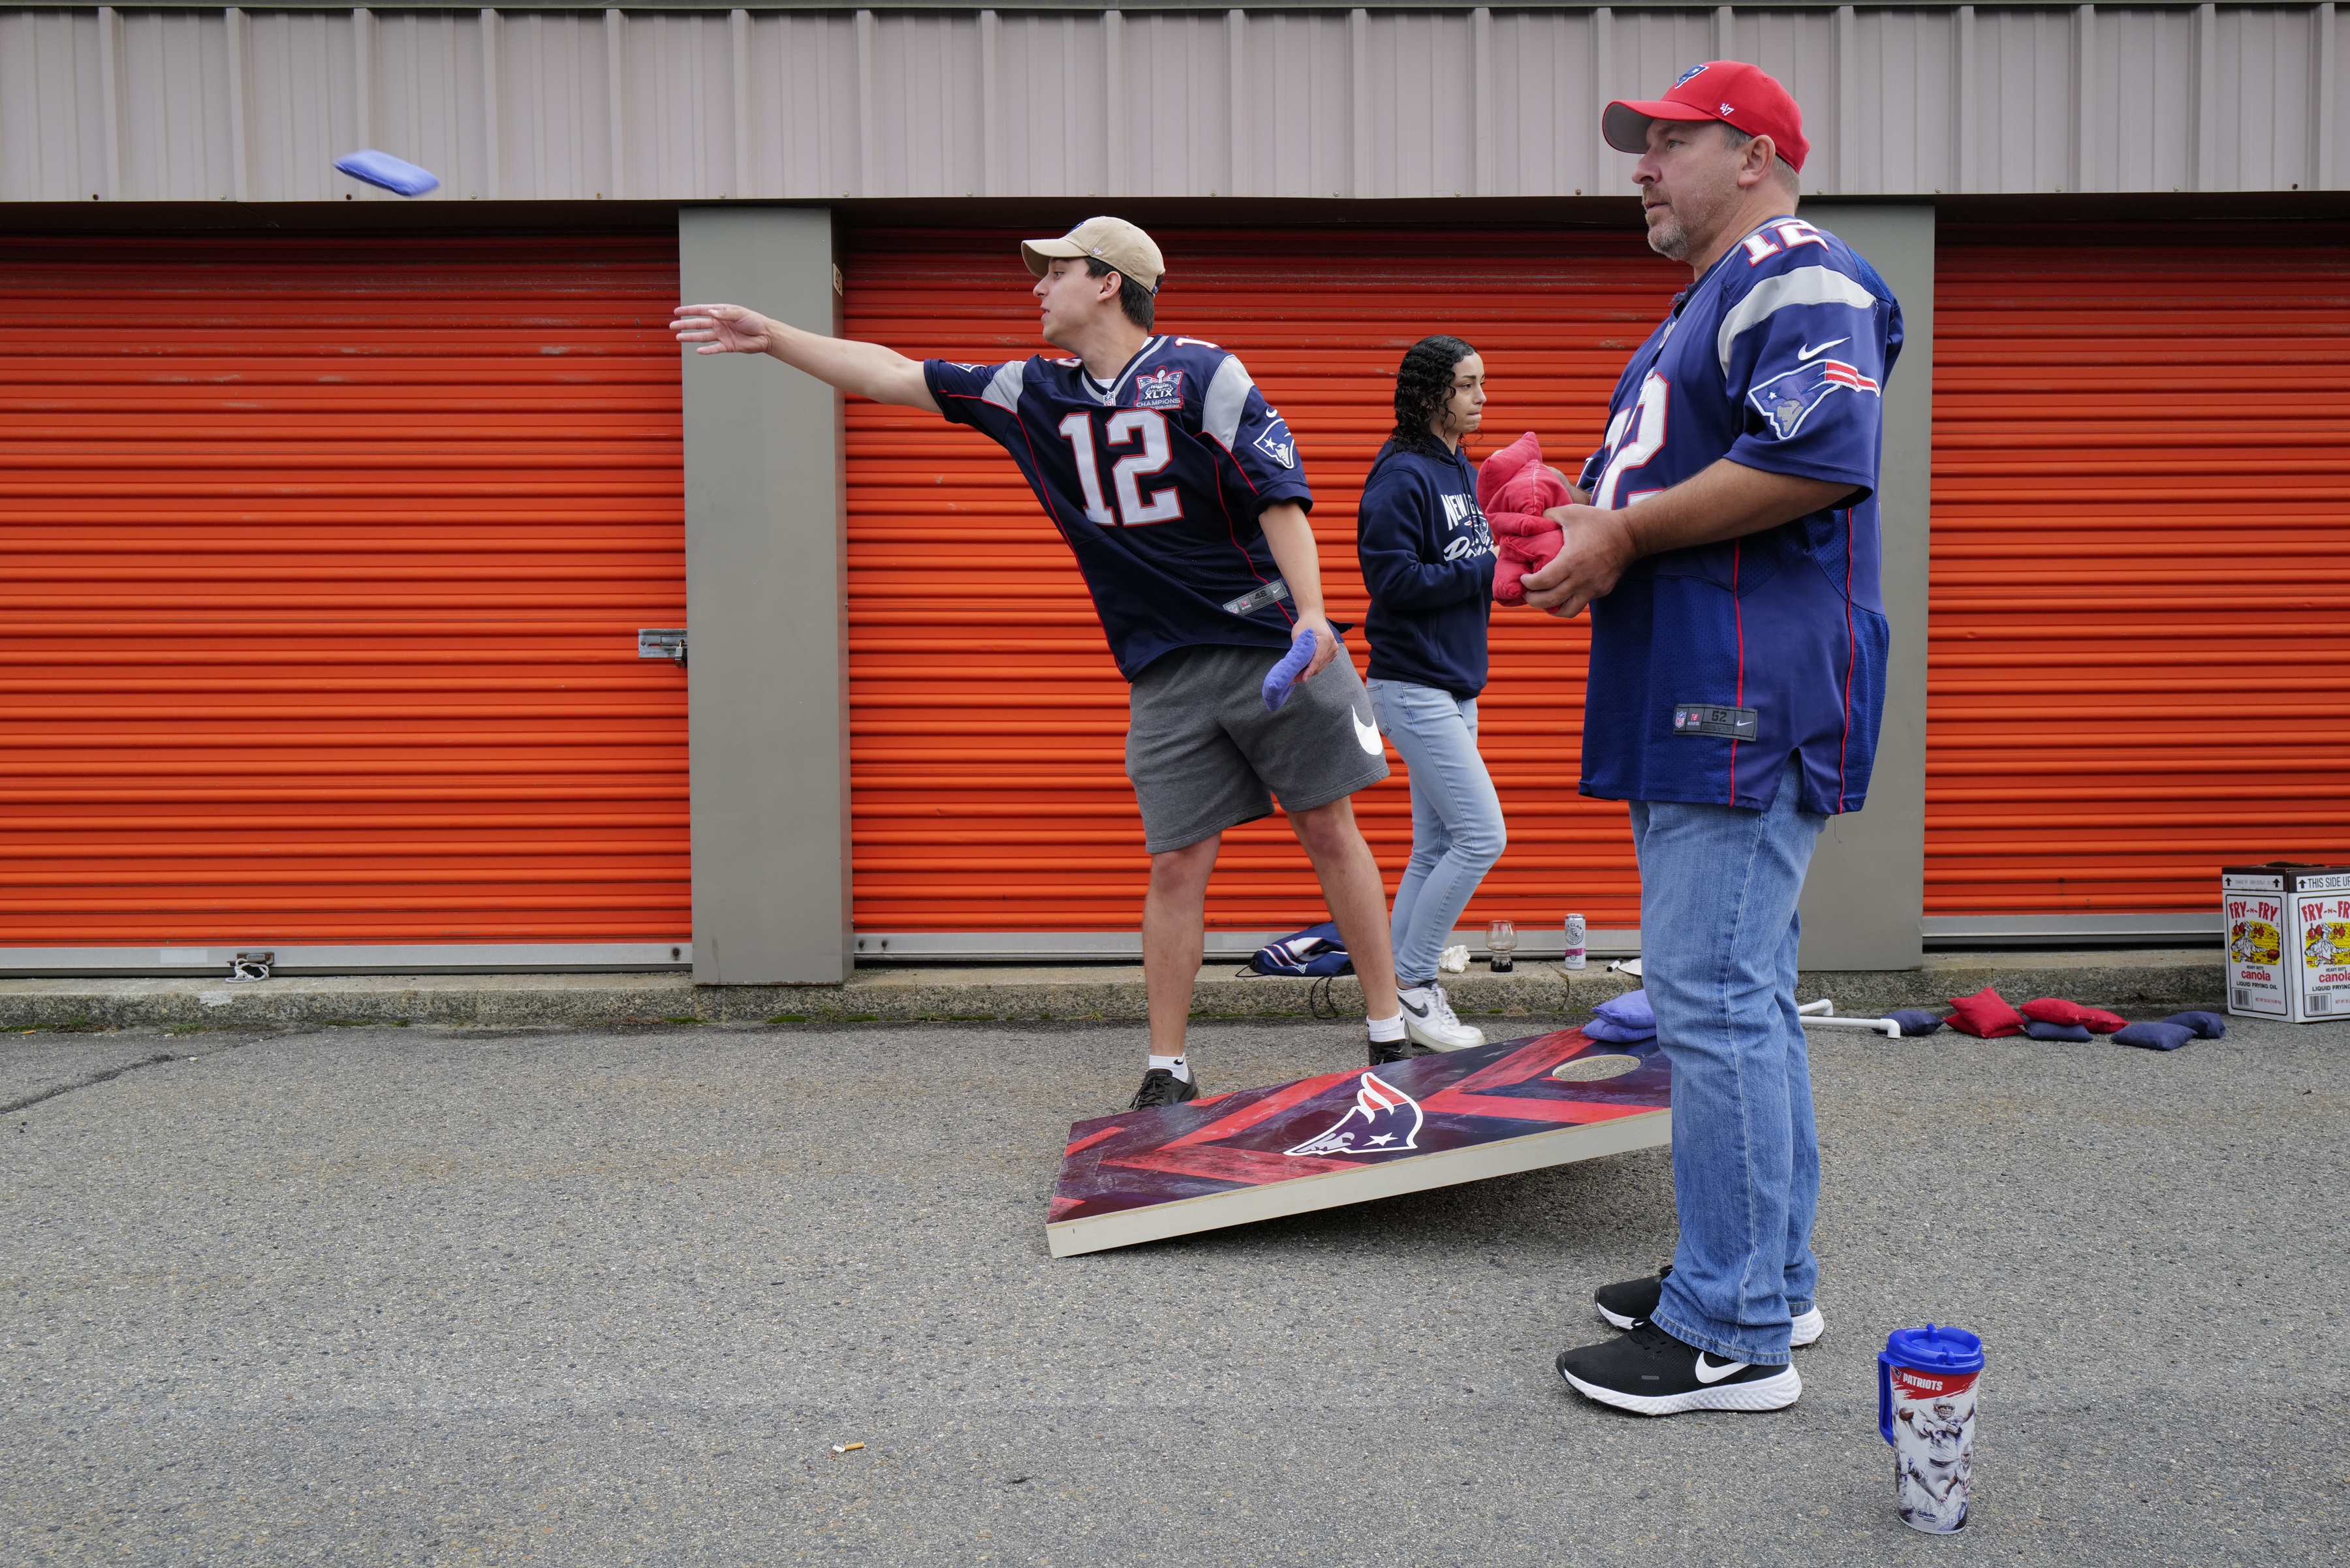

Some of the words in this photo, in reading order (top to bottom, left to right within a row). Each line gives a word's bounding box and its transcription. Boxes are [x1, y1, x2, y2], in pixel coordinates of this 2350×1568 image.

[1144, 389, 1174, 400] XLIX
[1136, 398, 1181, 407] CHAMPIONS
[1059, 408, 1184, 527] 12
[1441, 494, 1467, 531] NEW
[1254, 590, 1268, 600] 48
[1711, 710, 1727, 723] 52
[2308, 877, 2324, 888] THIS
[2325, 877, 2341, 888] SIDE
[2241, 970, 2271, 981] canola
[1903, 1372, 1943, 1391] PATRIOTS
[1917, 1510, 1936, 1518] Gillette
